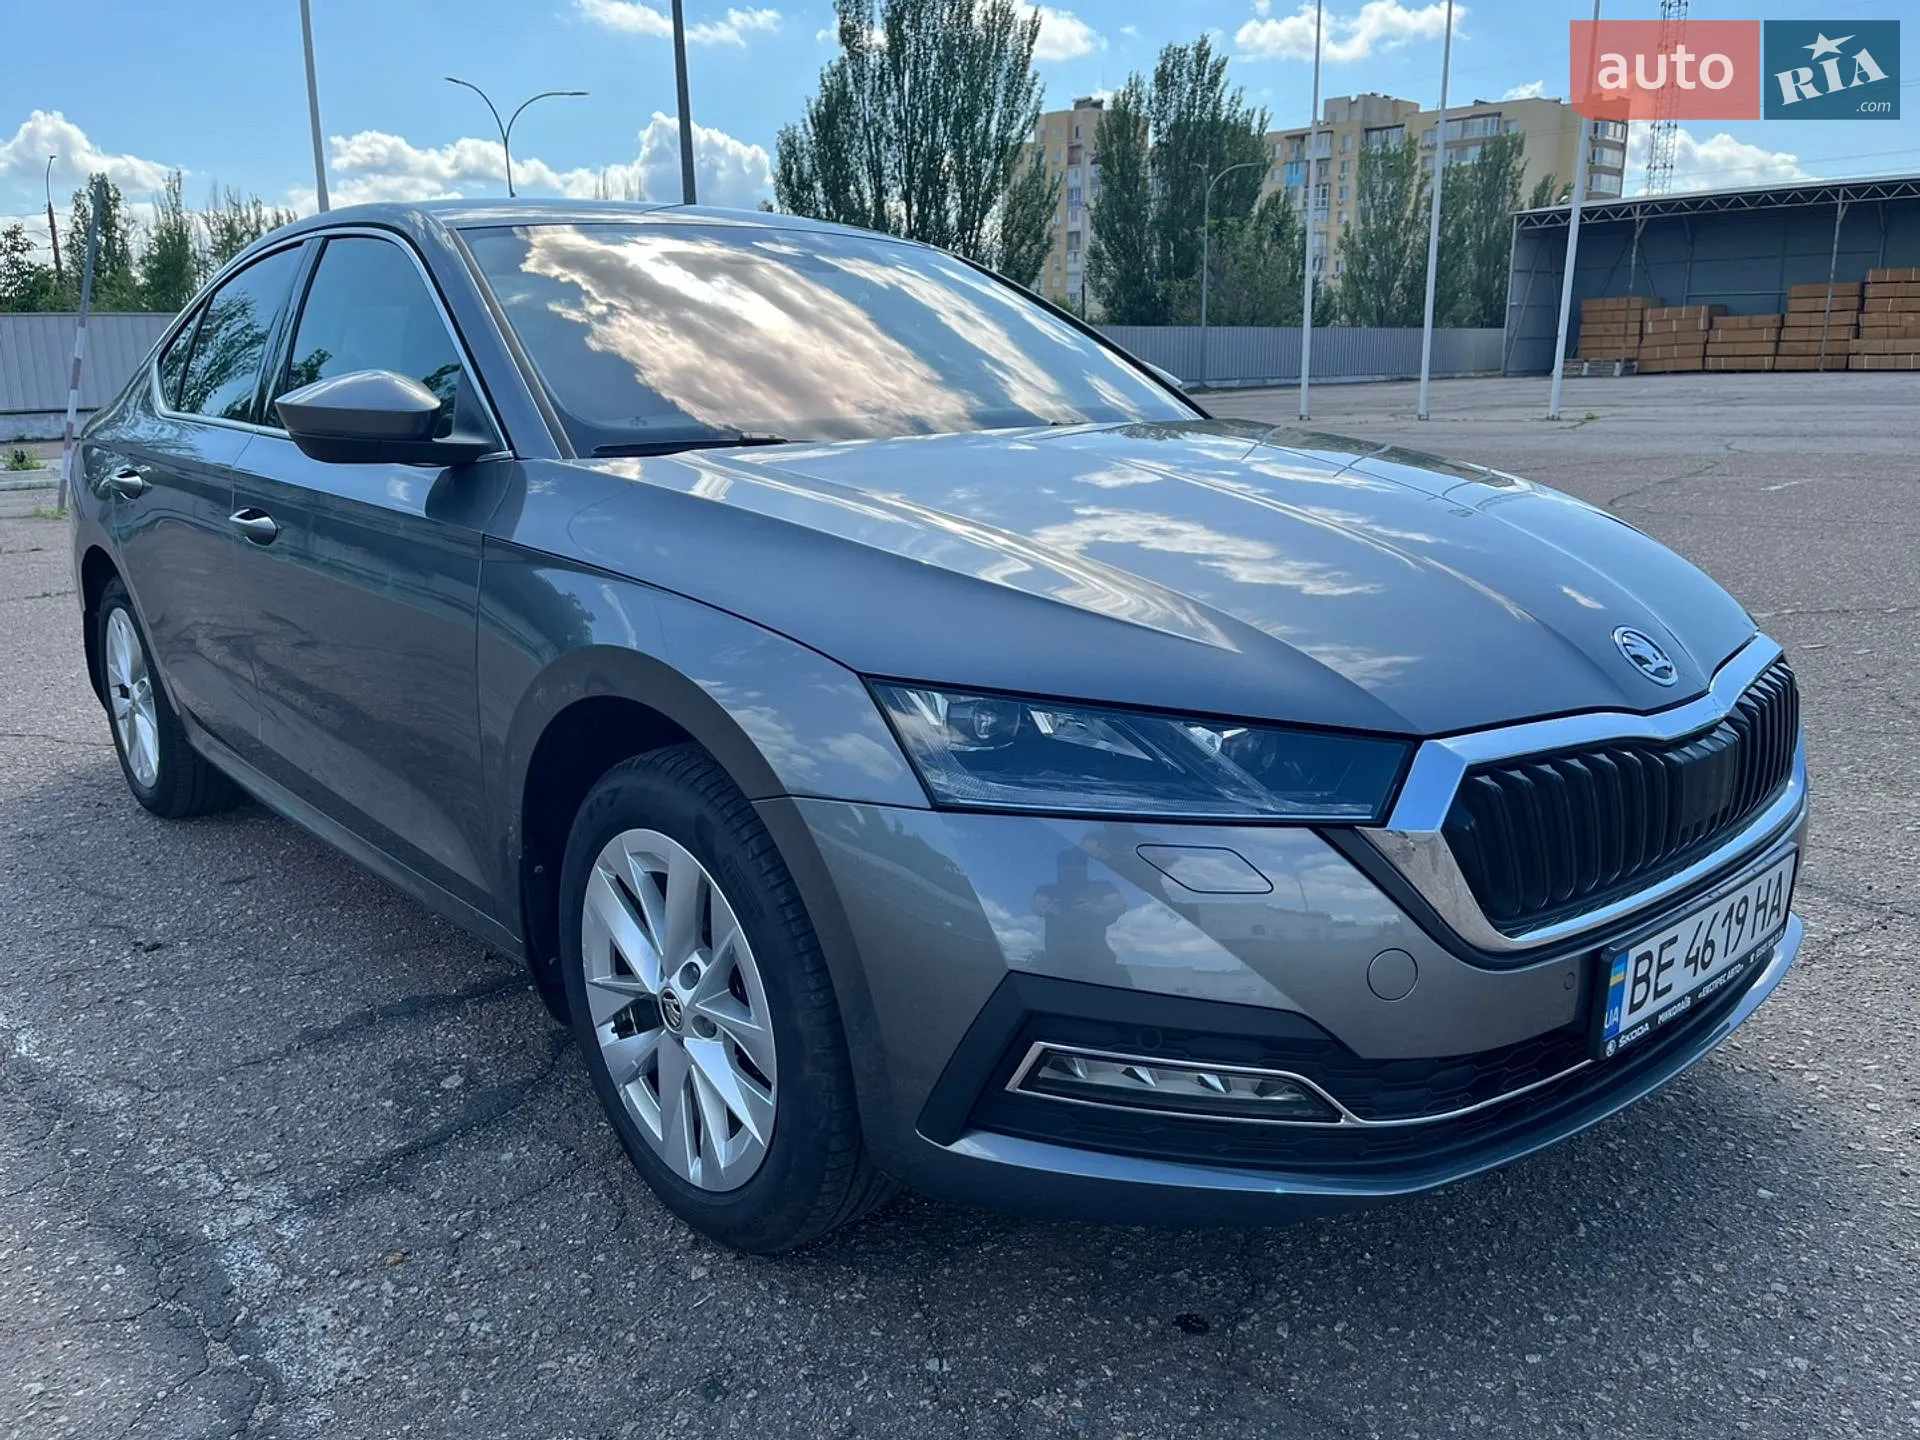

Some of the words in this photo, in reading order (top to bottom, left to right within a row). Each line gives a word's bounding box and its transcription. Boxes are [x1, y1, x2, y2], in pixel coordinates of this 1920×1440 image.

[1628, 934, 1679, 1016] BE
[1683, 894, 1749, 977] 4619
[1751, 870, 1784, 940] HA
[1604, 1006, 1619, 1029] UA
